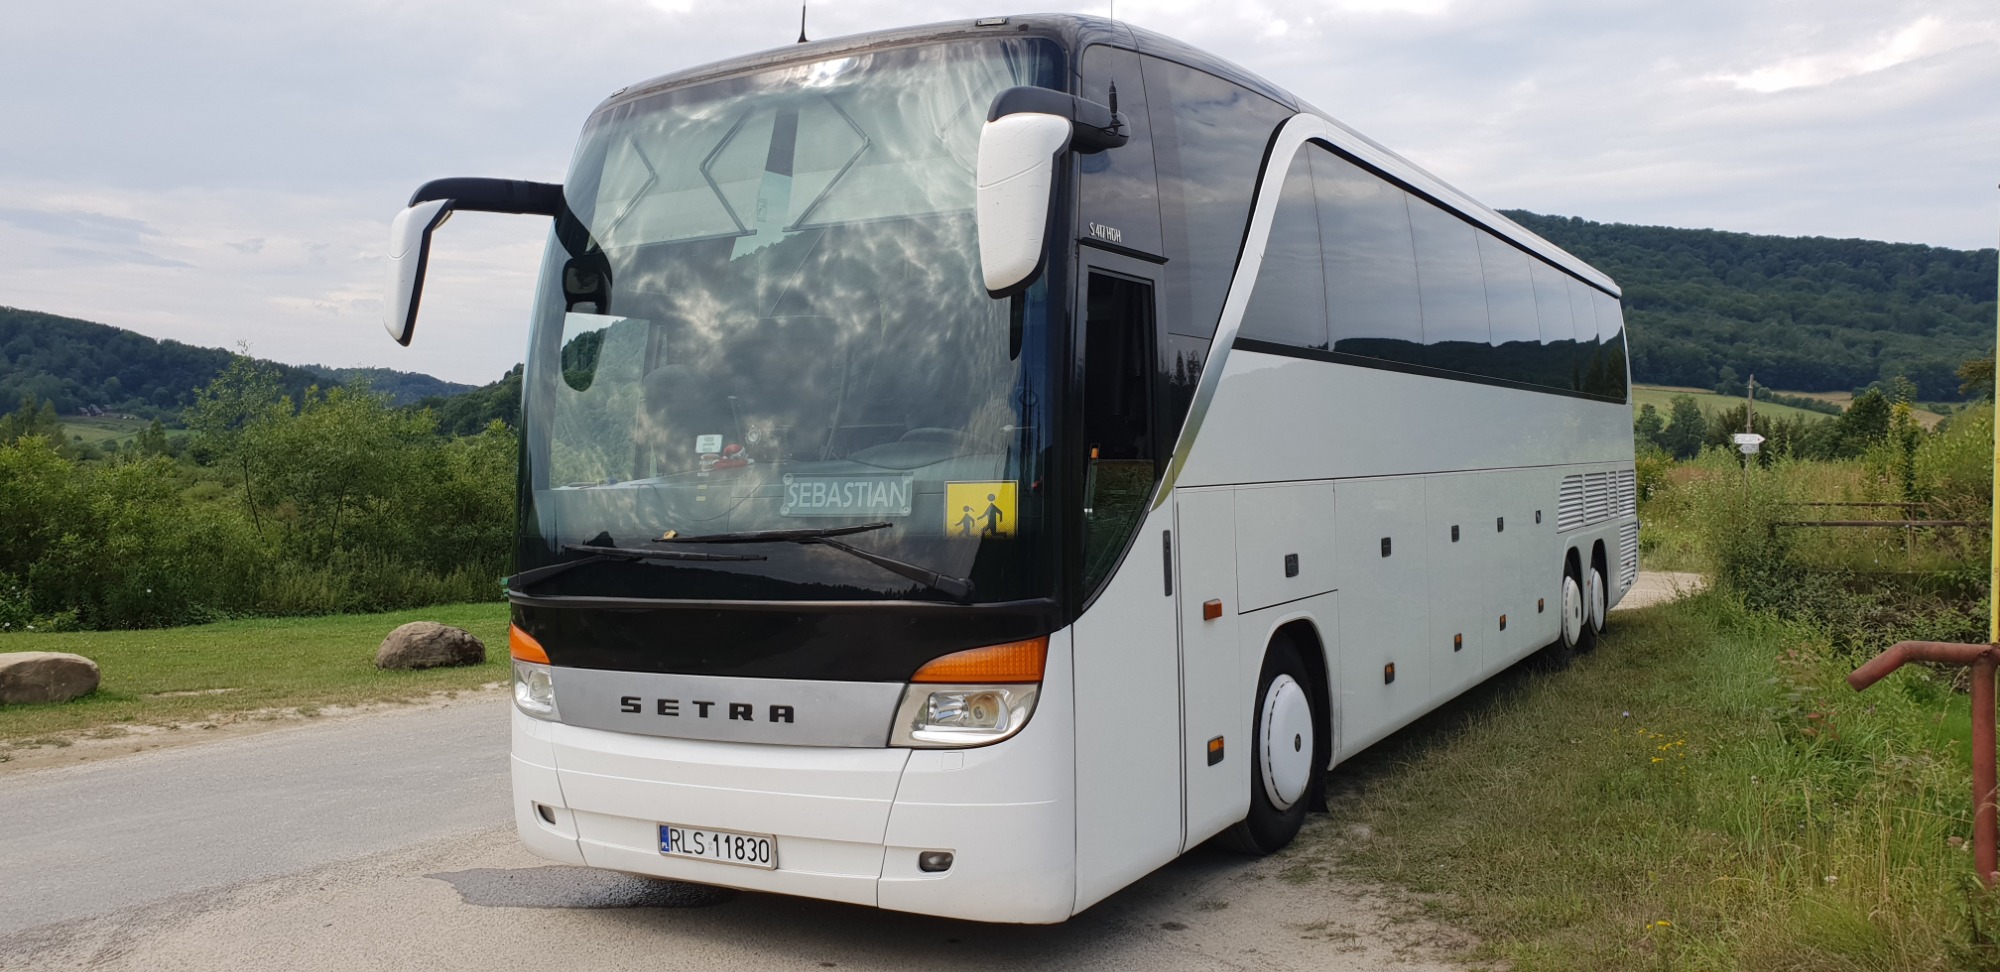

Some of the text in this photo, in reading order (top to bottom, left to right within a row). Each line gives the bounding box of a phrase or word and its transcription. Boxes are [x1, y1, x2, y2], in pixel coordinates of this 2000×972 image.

[1089, 222, 1095, 236] S
[787, 481, 907, 508] SEBASTIAN
[620, 695, 795, 724] SETRA
[669, 828, 770, 863] RLS 11830
